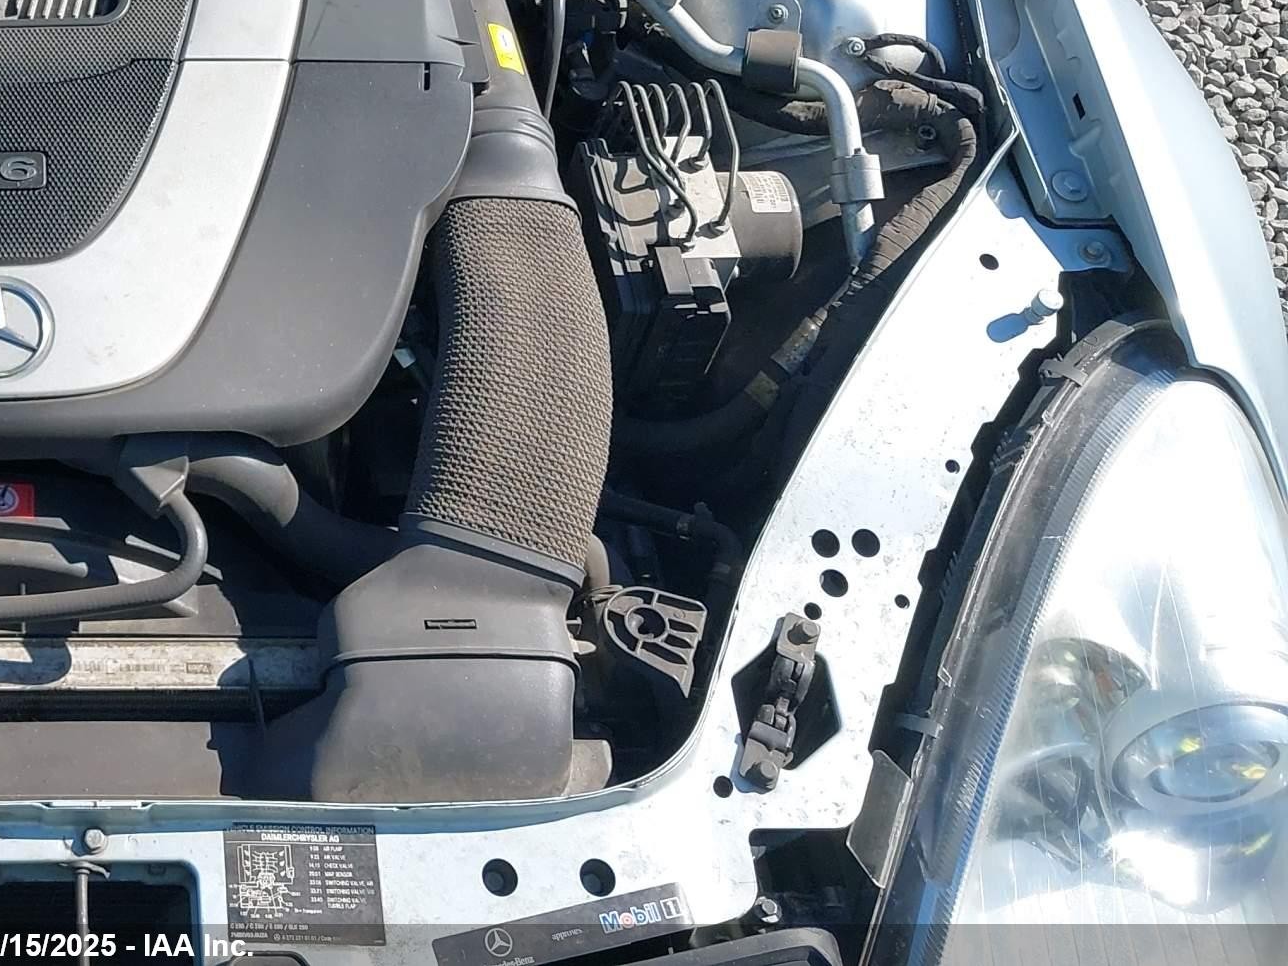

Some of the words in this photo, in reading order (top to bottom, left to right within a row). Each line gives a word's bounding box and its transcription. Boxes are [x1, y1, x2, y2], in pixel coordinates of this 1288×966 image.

[291, 825, 325, 834] CONTROL
[326, 826, 374, 835] INFORMATION
[261, 833, 328, 842] DAIMLERCHRYSLER
[599, 902, 661, 934] Mobil
[551, 928, 583, 941] approves
